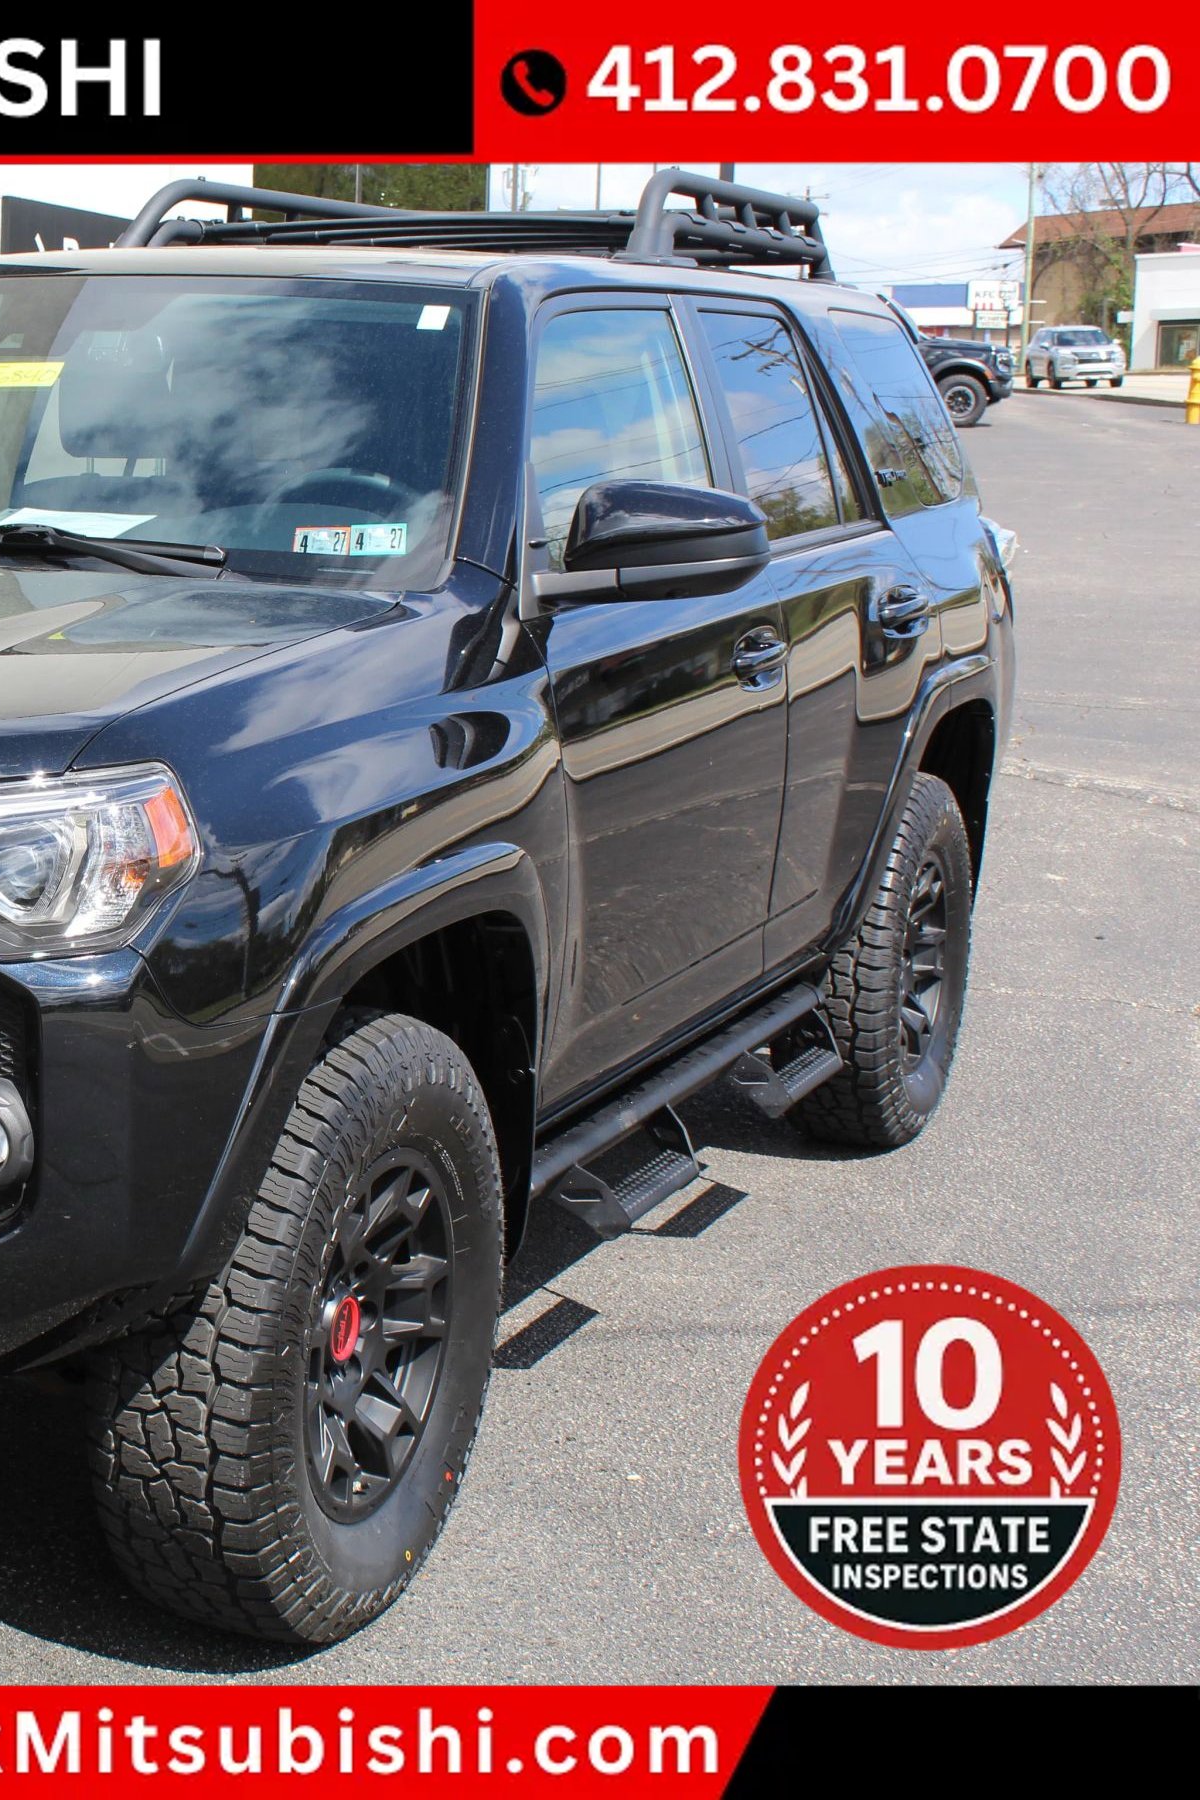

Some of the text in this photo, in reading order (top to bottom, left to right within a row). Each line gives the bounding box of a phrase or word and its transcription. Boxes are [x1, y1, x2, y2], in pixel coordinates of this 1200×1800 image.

[333, 532, 347, 552] 27
[356, 528, 403, 551] 4 27
